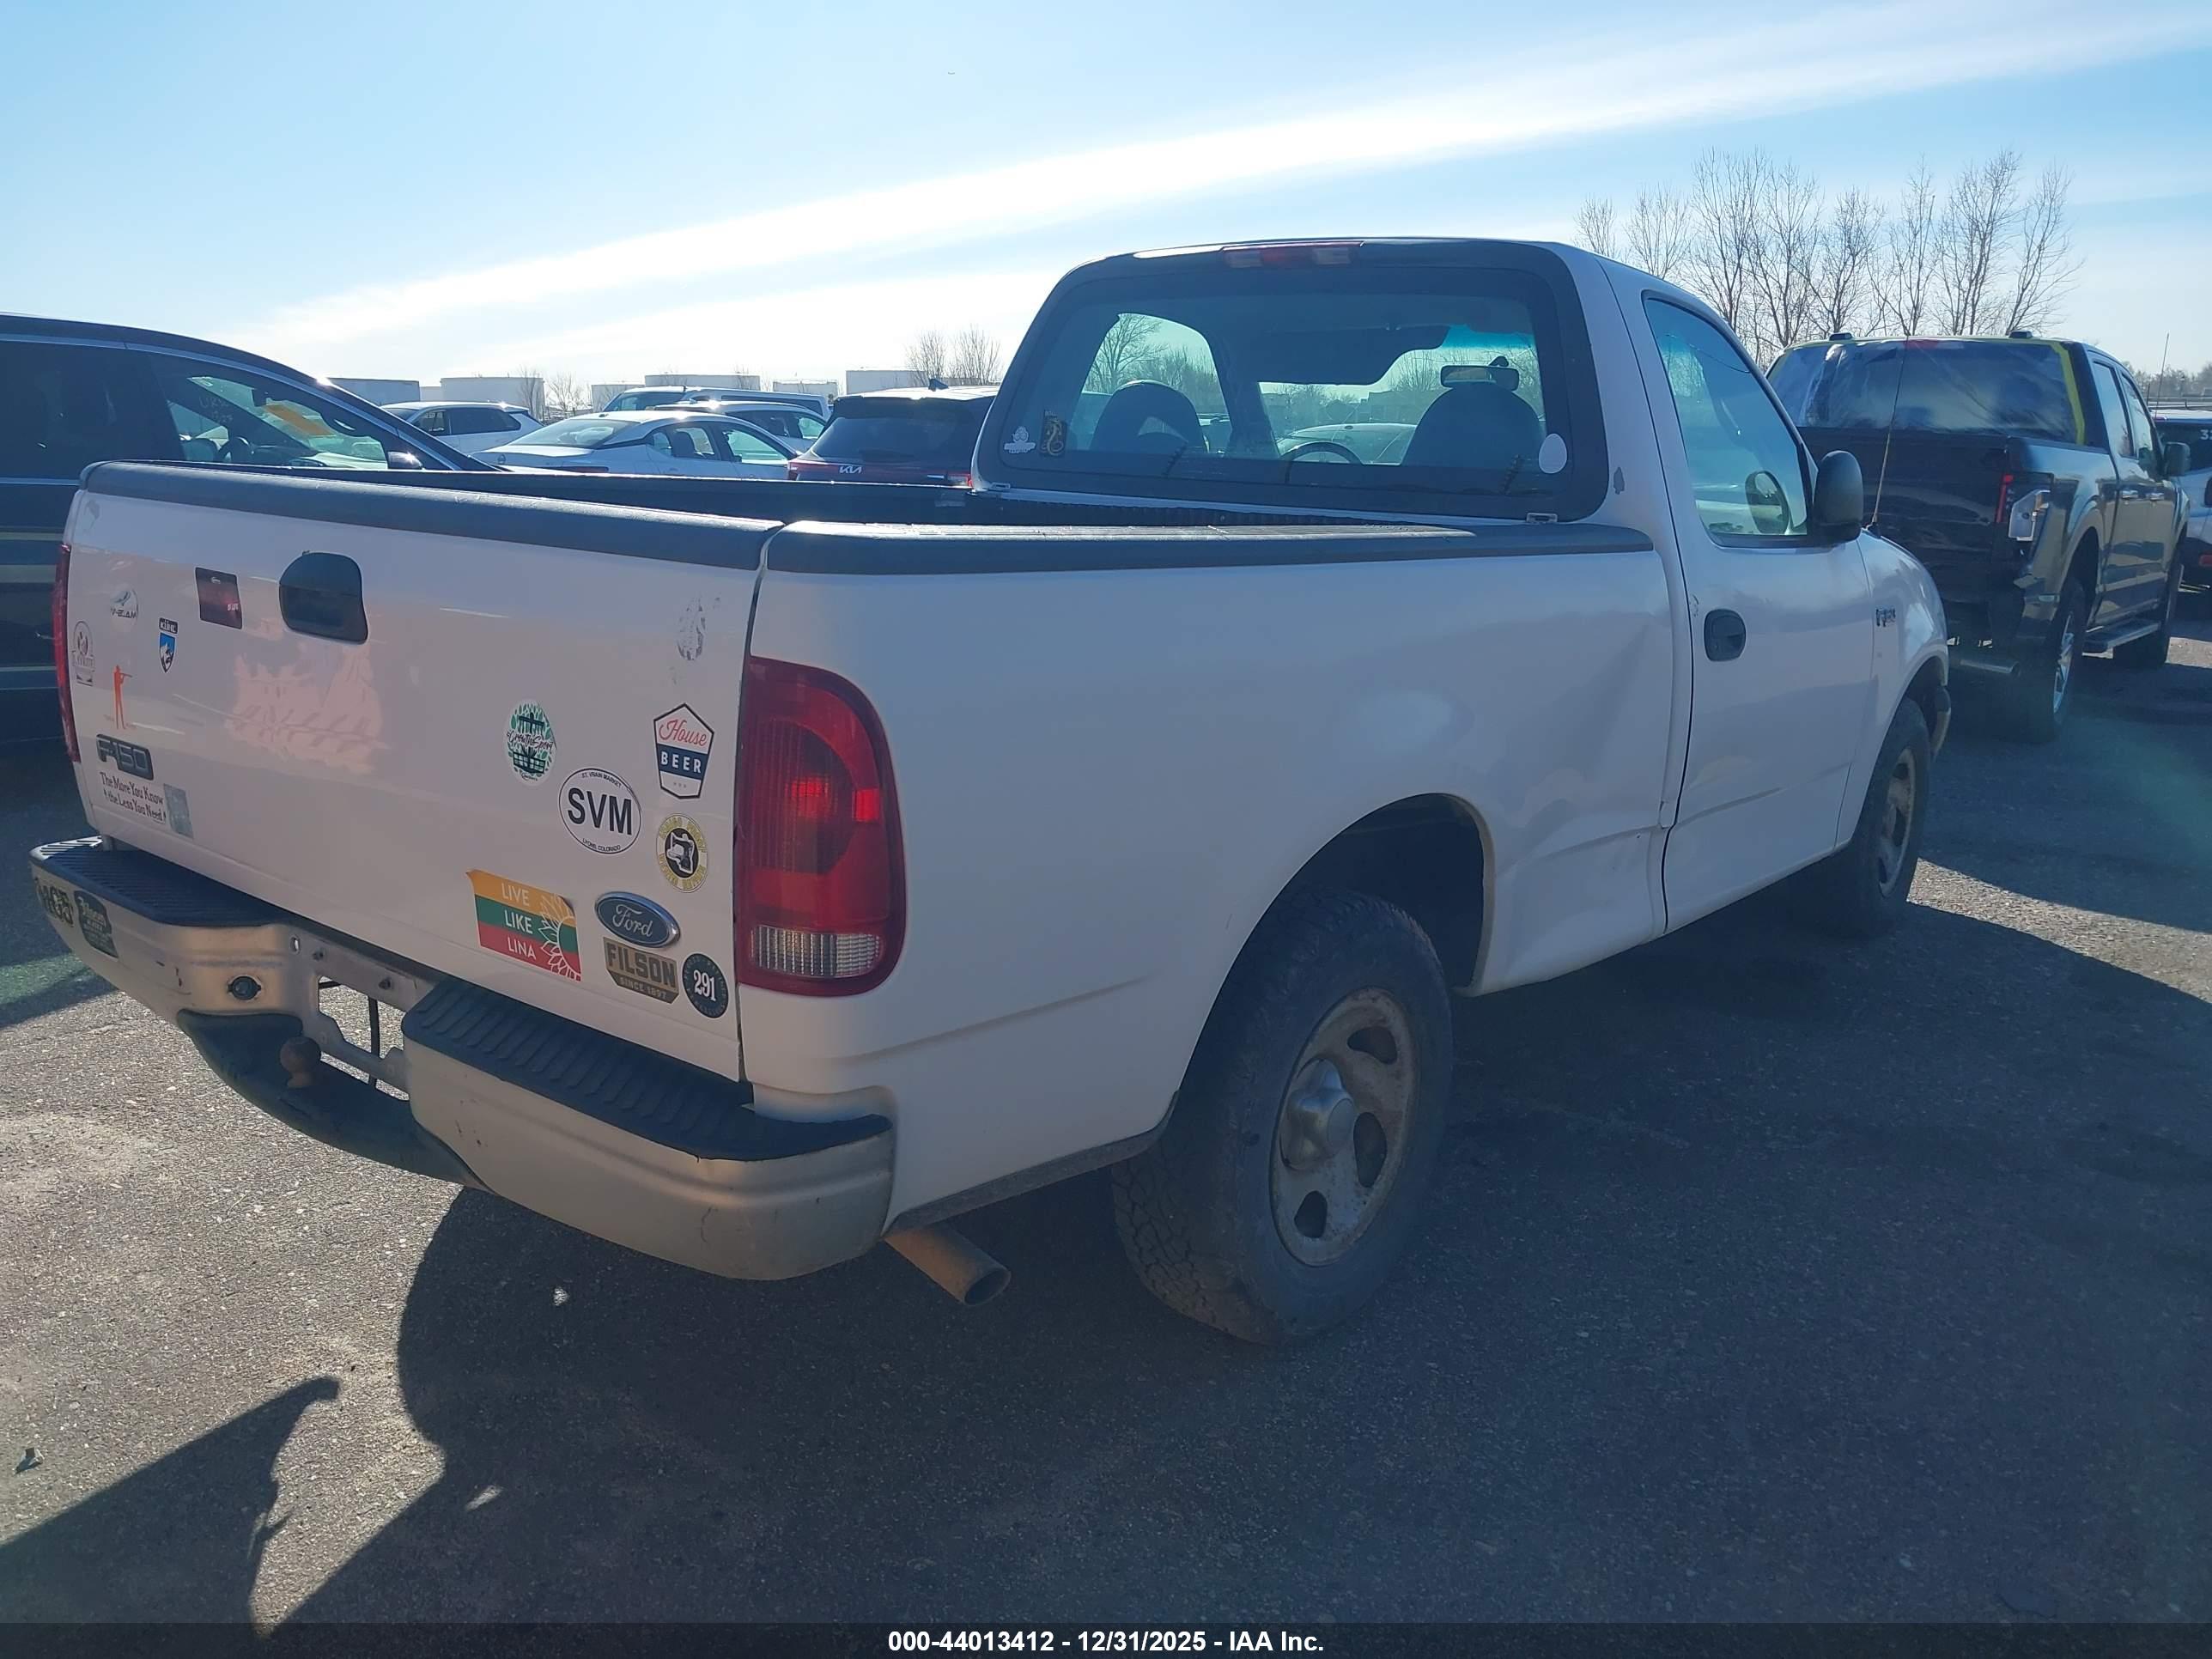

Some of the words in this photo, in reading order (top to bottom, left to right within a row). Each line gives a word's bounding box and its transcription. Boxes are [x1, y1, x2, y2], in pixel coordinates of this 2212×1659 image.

[659, 718, 708, 747] House
[660, 750, 702, 774] BEER
[100, 772, 113, 787] The
[112, 775, 131, 794] More
[129, 781, 143, 799] You
[143, 786, 164, 805] Know
[117, 793, 134, 811] Less
[132, 798, 146, 816] You
[568, 787, 632, 836] SVM
[501, 883, 530, 907] LIVE
[504, 909, 533, 934] LIKE
[612, 903, 653, 938] Ford
[507, 937, 537, 960] LINA
[606, 942, 676, 988] FILSON
[693, 969, 717, 1002] 291
